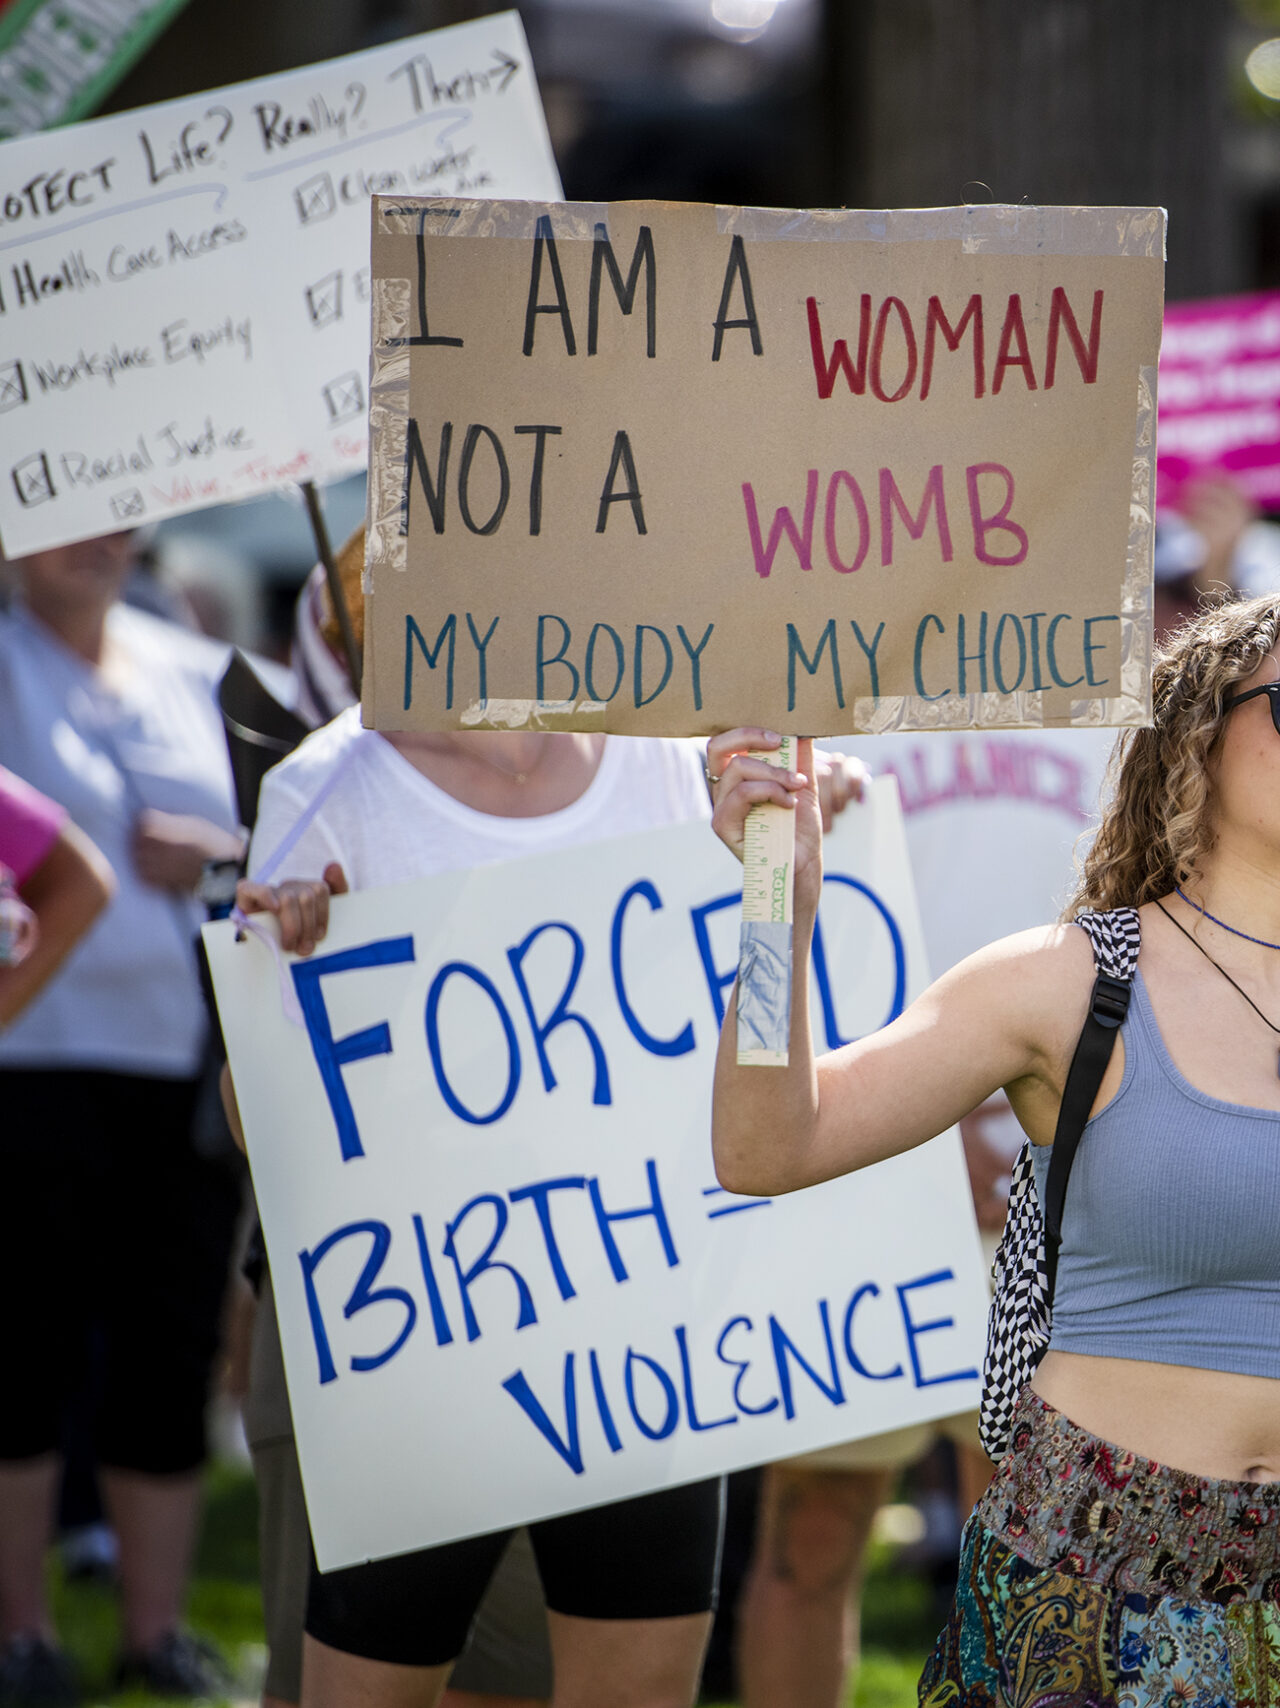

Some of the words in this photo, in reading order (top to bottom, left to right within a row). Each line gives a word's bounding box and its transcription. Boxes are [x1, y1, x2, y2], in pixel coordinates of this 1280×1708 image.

[0, 157, 117, 226] OTECT
[138, 105, 234, 185] Life?
[254, 81, 367, 153] Really?
[386, 53, 490, 114] Then
[11, 249, 101, 306] Health
[107, 243, 164, 282] Care
[166, 217, 249, 263] Access
[384, 207, 464, 348] I
[522, 214, 656, 358] AM
[712, 234, 763, 362] A
[806, 286, 1104, 403] WOMAN
[29, 341, 155, 393] Workplace
[160, 315, 254, 363] Equity
[60, 432, 154, 488] Racial
[155, 415, 254, 467] Justice
[401, 418, 562, 537] NOT
[595, 430, 648, 535] A
[742, 462, 1029, 578] WOMB
[404, 612, 499, 711] MY
[536, 614, 714, 711] BODY
[786, 619, 886, 712] MY
[914, 611, 1120, 702] CHOICE
[298, 1159, 679, 1385] BIRTH
[501, 1268, 980, 1475] VIOLENCE
